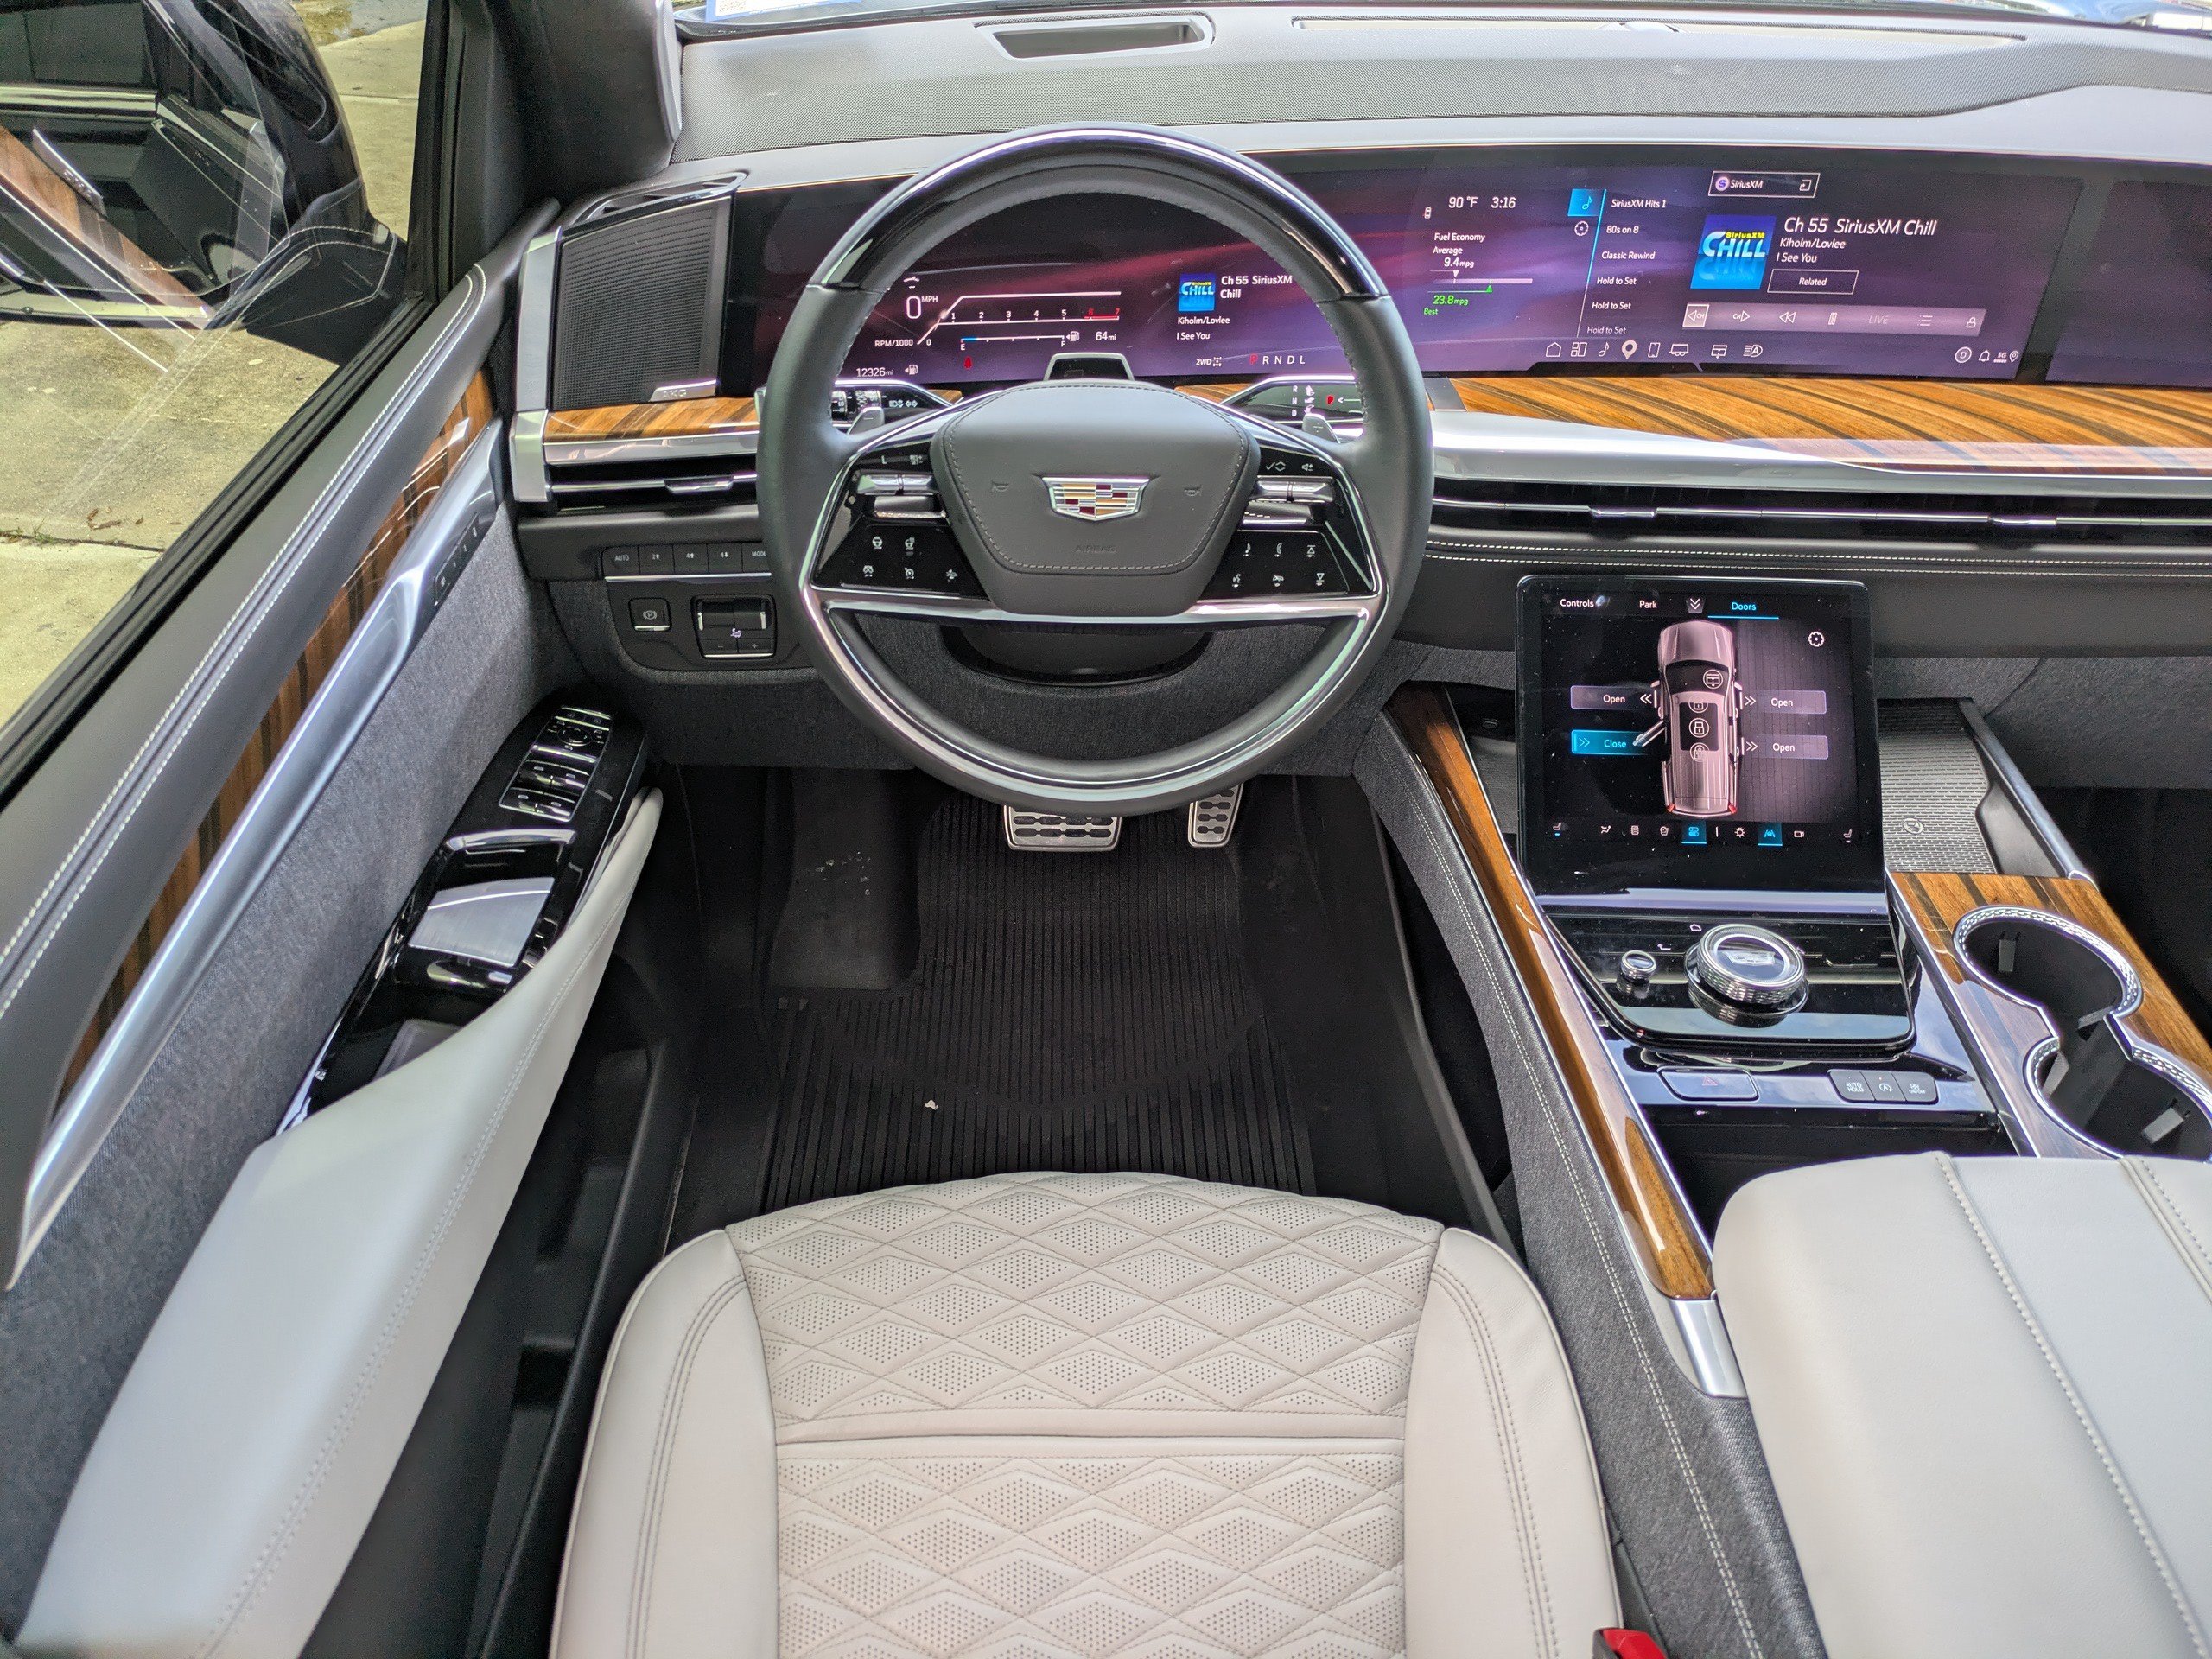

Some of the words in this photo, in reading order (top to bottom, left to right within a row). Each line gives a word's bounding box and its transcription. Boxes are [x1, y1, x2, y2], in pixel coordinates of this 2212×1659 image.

[1730, 180, 1764, 189] SiriusXM
[1448, 197, 1464, 208] 90
[1466, 196, 1478, 208] °F
[1491, 197, 1516, 209] 3:16
[1611, 199, 1643, 208] SiriusXM
[1644, 200, 1660, 208] Hits
[1661, 200, 1666, 208] 1
[1606, 226, 1621, 234] 80s
[1632, 226, 1639, 234] 8
[1783, 217, 1803, 232] Ch
[1808, 218, 1829, 233] 55
[1834, 218, 1901, 235] SiriusXM
[1904, 219, 1937, 236] Chill
[1433, 232, 1451, 241] Fuel
[1452, 232, 1485, 243] Economy
[1702, 232, 1766, 257] CHILL
[1780, 238, 1847, 249] Kiholm/Lovlee
[1432, 246, 1463, 257] Average
[1601, 251, 1627, 260] Classic
[1628, 251, 1656, 260] Rewind
[1776, 252, 1780, 262] I
[1781, 253, 1799, 263] See
[1801, 253, 1818, 263] You
[1221, 276, 1234, 285] Ch
[1236, 276, 1249, 285] 55
[1252, 275, 1293, 285] SiriusXM
[1597, 276, 1614, 285] Hold
[1624, 276, 1637, 285] Set
[1798, 277, 1827, 286] Related
[1180, 282, 1215, 296] CHILL
[1220, 289, 1242, 299] Chill
[906, 296, 921, 319] 0
[1592, 302, 1610, 310] Hold
[1619, 302, 1631, 310] Set
[1006, 310, 1012, 319] 3
[1869, 315, 1890, 324] LIVE
[1178, 316, 1230, 325] Kiholm/Lovlee
[1586, 326, 1605, 334] Hold
[1180, 332, 1195, 340] See
[1196, 332, 1211, 340] You
[1249, 353, 1258, 365] P
[1262, 356, 1269, 365] R
[1274, 355, 1281, 365] N
[1287, 355, 1294, 365] D
[1300, 355, 1306, 364] L
[1560, 598, 1594, 608] Controls
[1639, 600, 1657, 609] Park
[1732, 602, 1757, 612] Doors
[1603, 695, 1625, 705] Open
[1770, 698, 1794, 709] Open
[1604, 739, 1627, 748] Close
[1772, 743, 1796, 753] Open
